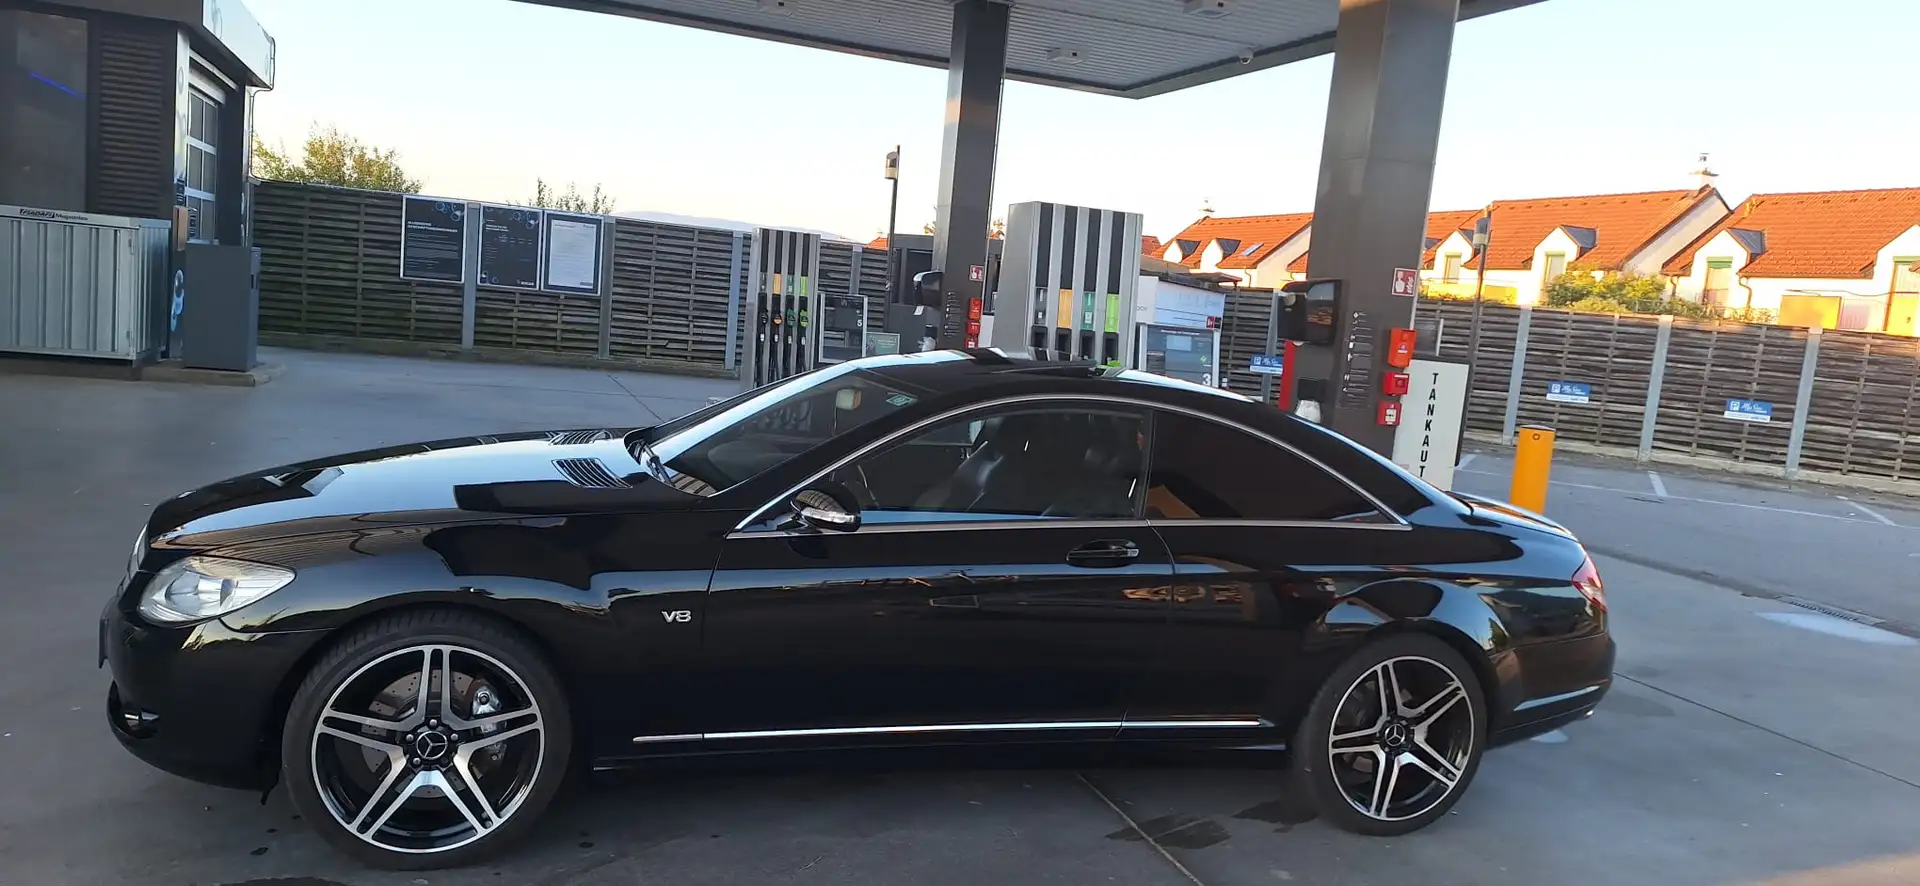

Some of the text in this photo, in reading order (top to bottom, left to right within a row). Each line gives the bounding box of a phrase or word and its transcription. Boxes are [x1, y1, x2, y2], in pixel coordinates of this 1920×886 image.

[1202, 373, 1211, 386] 3
[1419, 373, 1439, 477] TANKAUT
[661, 610, 691, 623] V8
